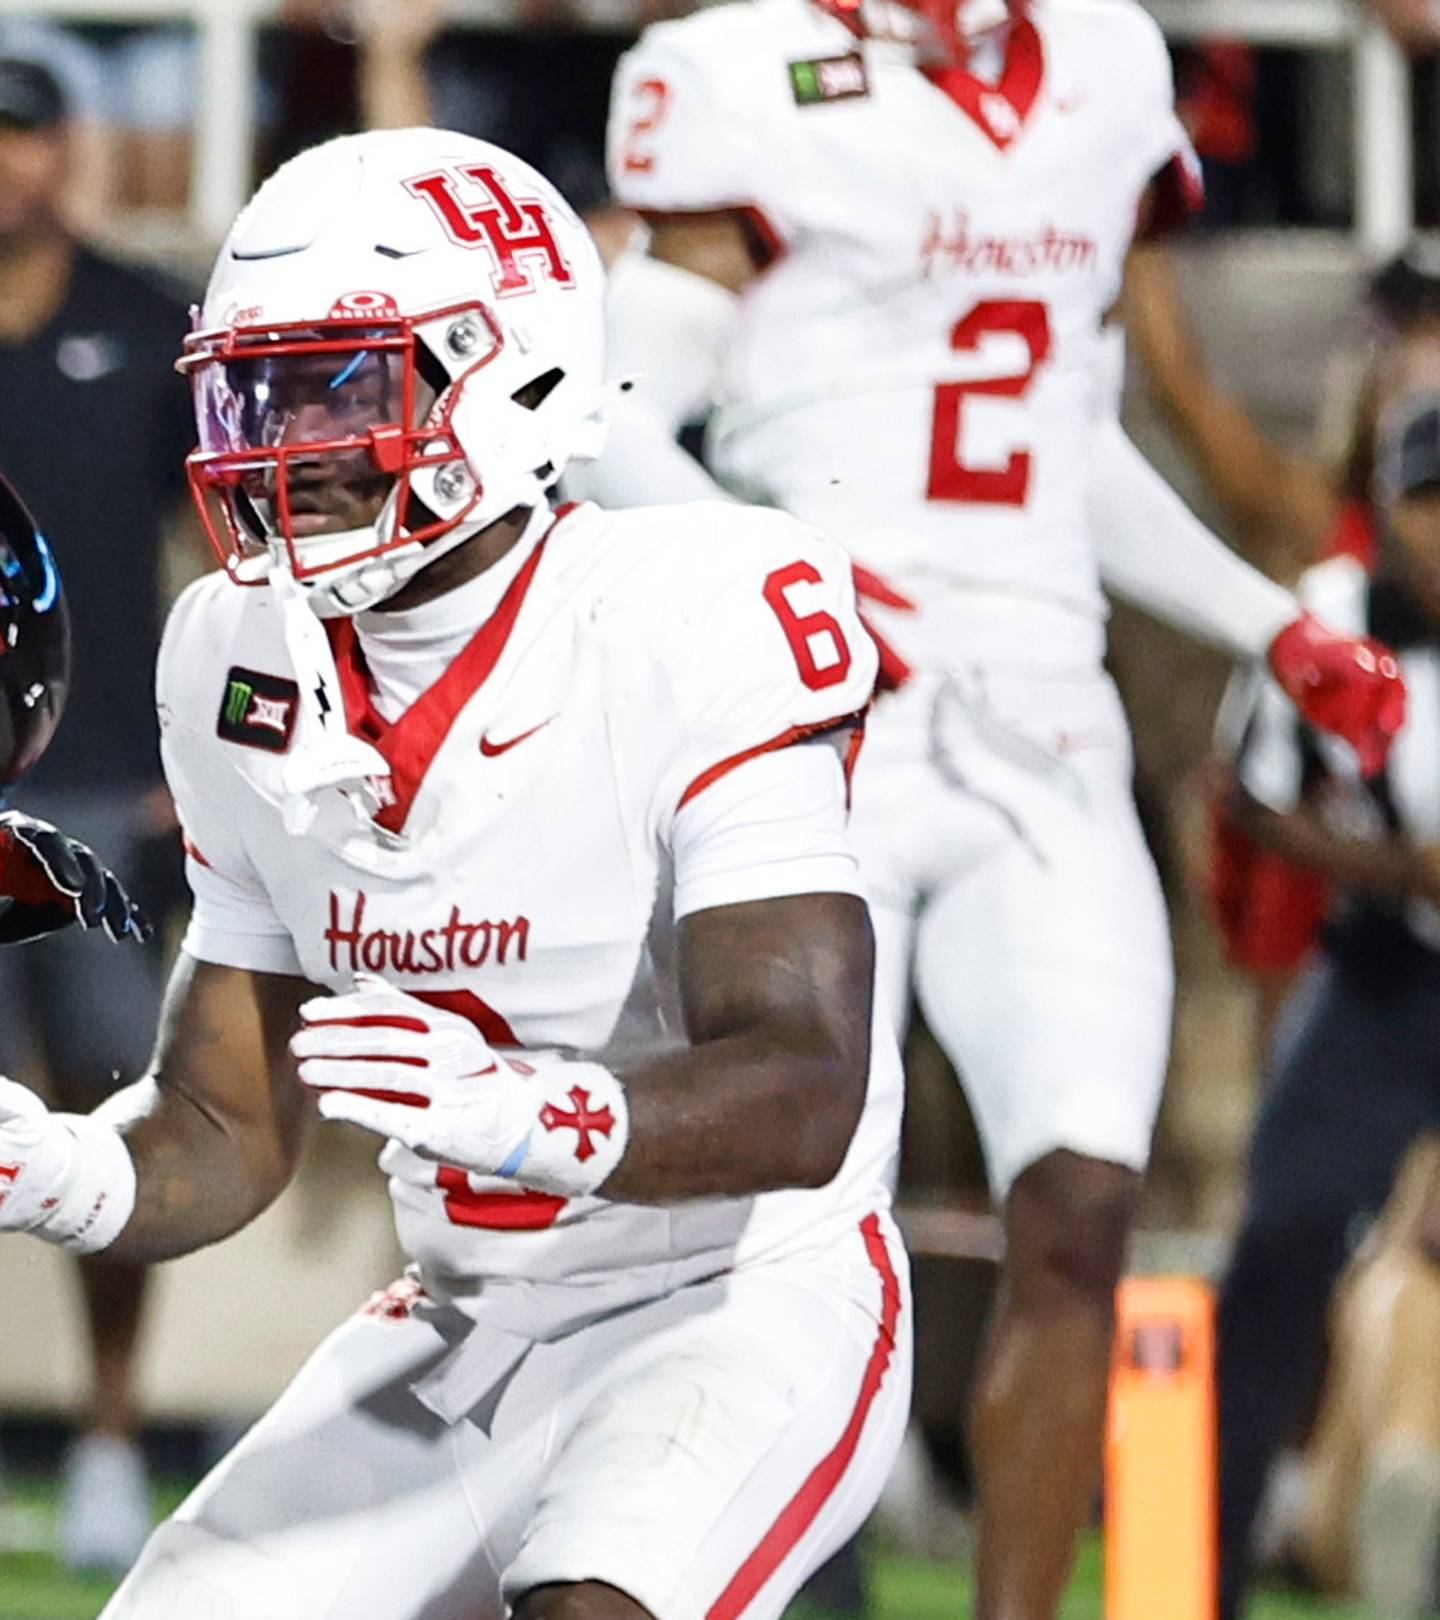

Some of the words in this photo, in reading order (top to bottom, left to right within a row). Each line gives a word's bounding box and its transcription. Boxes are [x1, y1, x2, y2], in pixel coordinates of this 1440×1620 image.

[403, 163, 577, 300] UH
[919, 206, 1098, 281] Houston
[925, 299, 1054, 508] 2
[763, 560, 852, 692] 6
[324, 890, 530, 974] Houston
